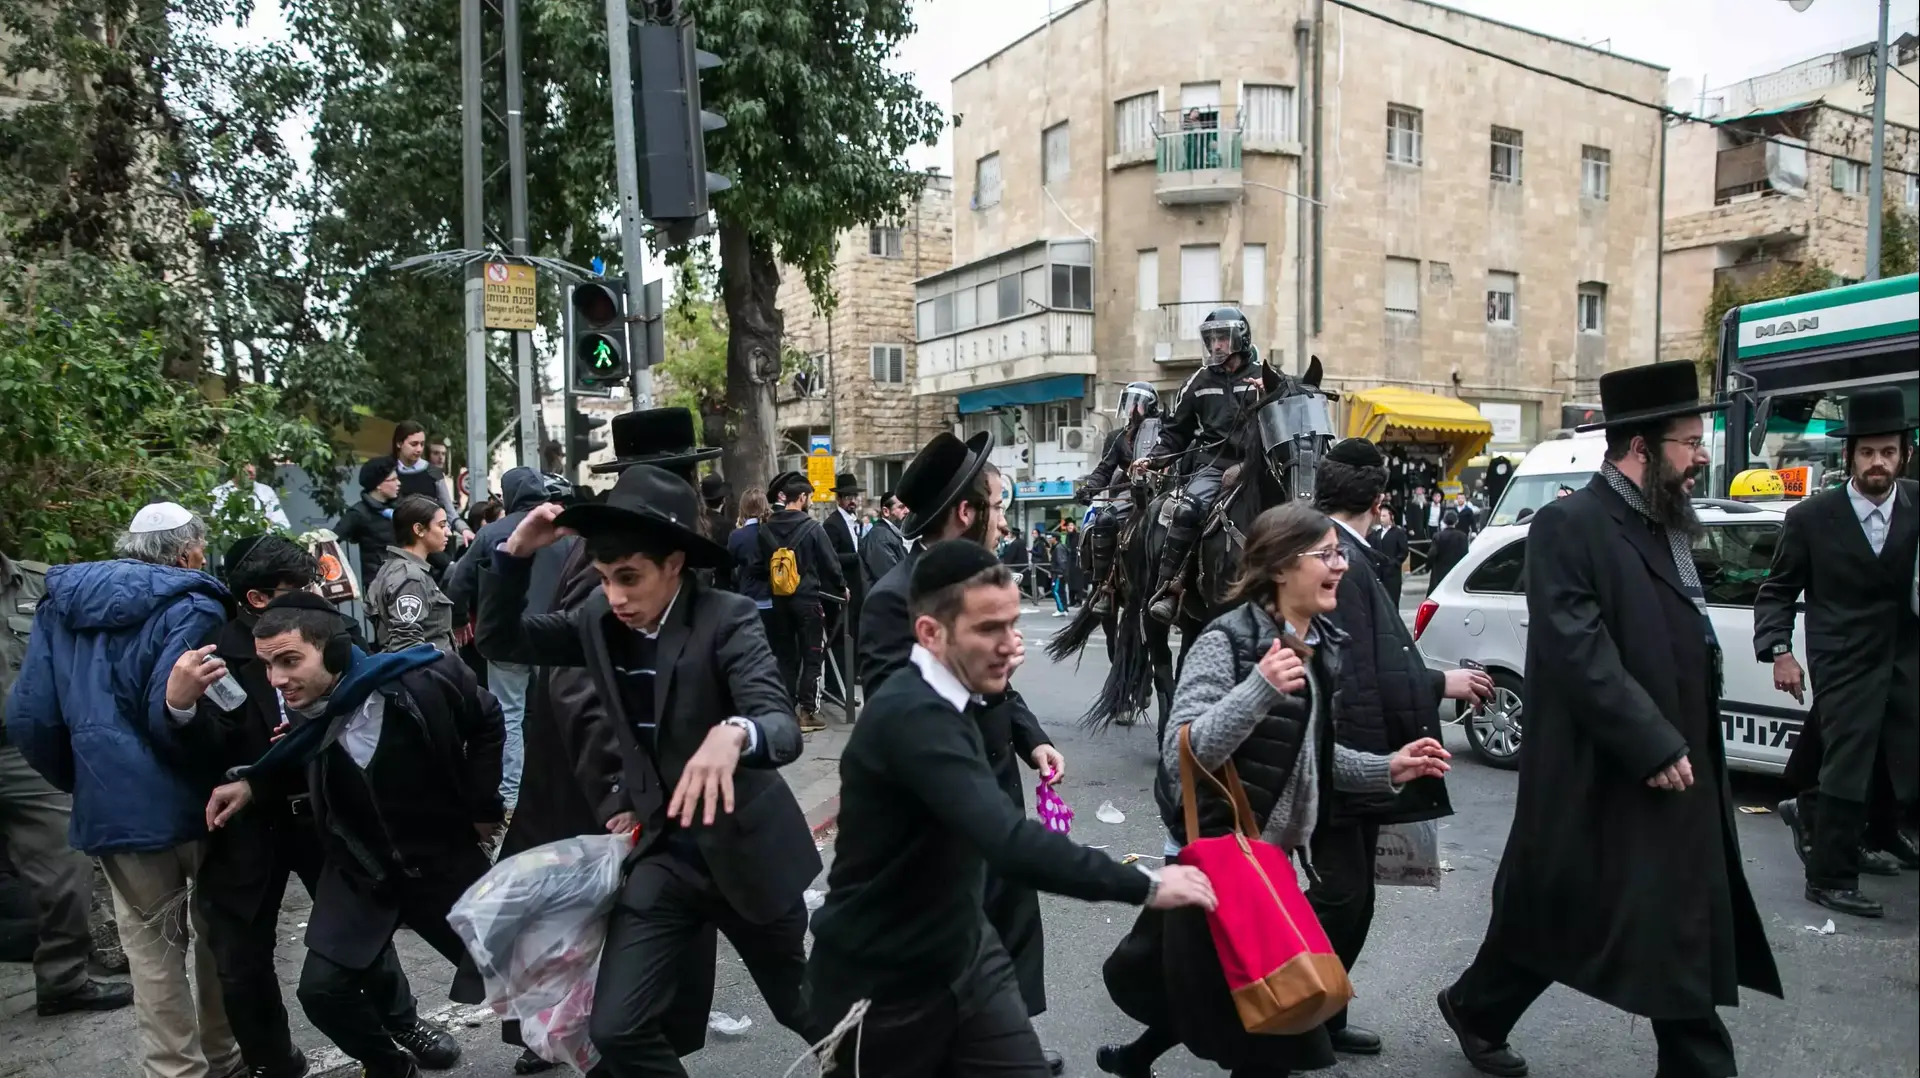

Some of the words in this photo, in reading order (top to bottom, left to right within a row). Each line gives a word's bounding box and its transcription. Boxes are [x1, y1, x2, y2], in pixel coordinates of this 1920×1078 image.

[515, 286, 534, 296] מתח
[512, 296, 534, 305] סכנת
[486, 304, 507, 313] Danger
[508, 305, 514, 313] of
[515, 305, 534, 314] Death!
[1755, 316, 1819, 339] MAN
